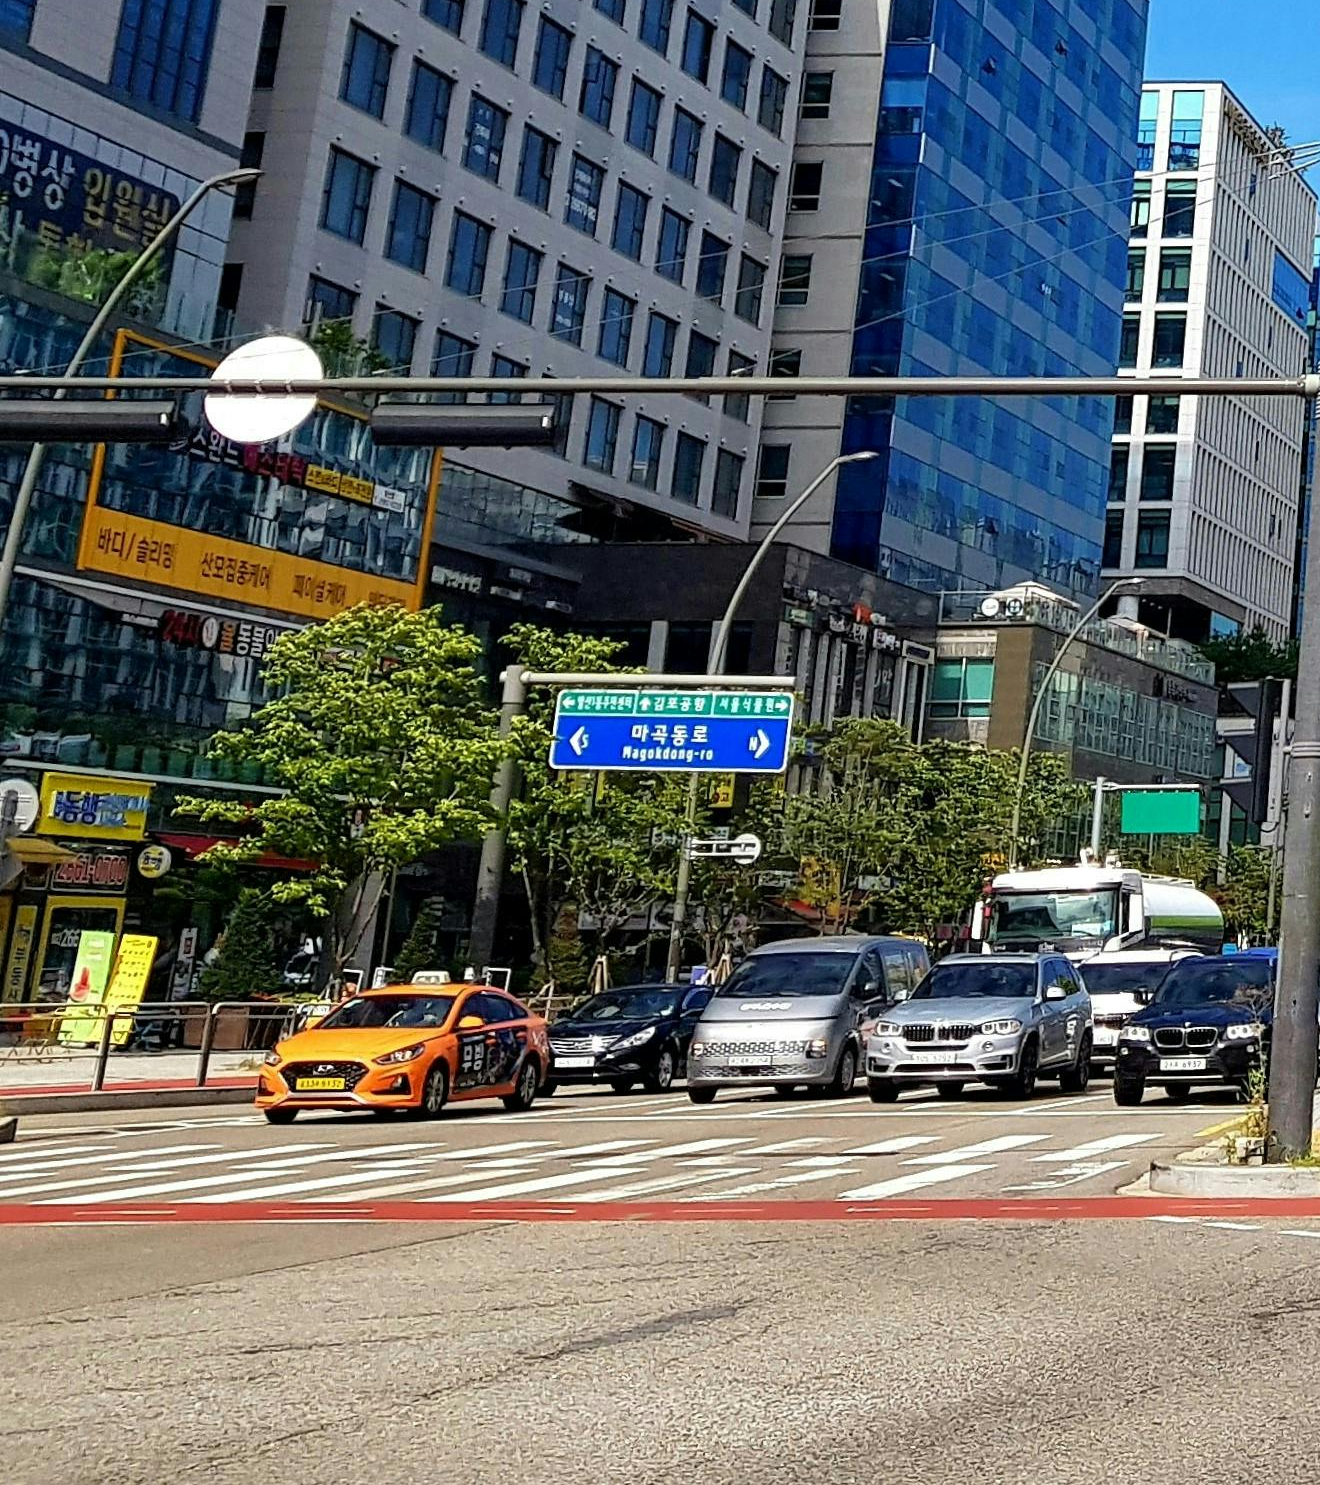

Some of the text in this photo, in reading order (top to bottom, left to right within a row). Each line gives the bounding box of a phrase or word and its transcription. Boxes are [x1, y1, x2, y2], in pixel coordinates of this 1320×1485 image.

[653, 696, 706, 712] 김포공항
[719, 697, 776, 713] 서울식물원
[580, 733, 589, 749] S
[631, 724, 709, 746] 마곡동로
[622, 745, 714, 762] Magokdong-ro
